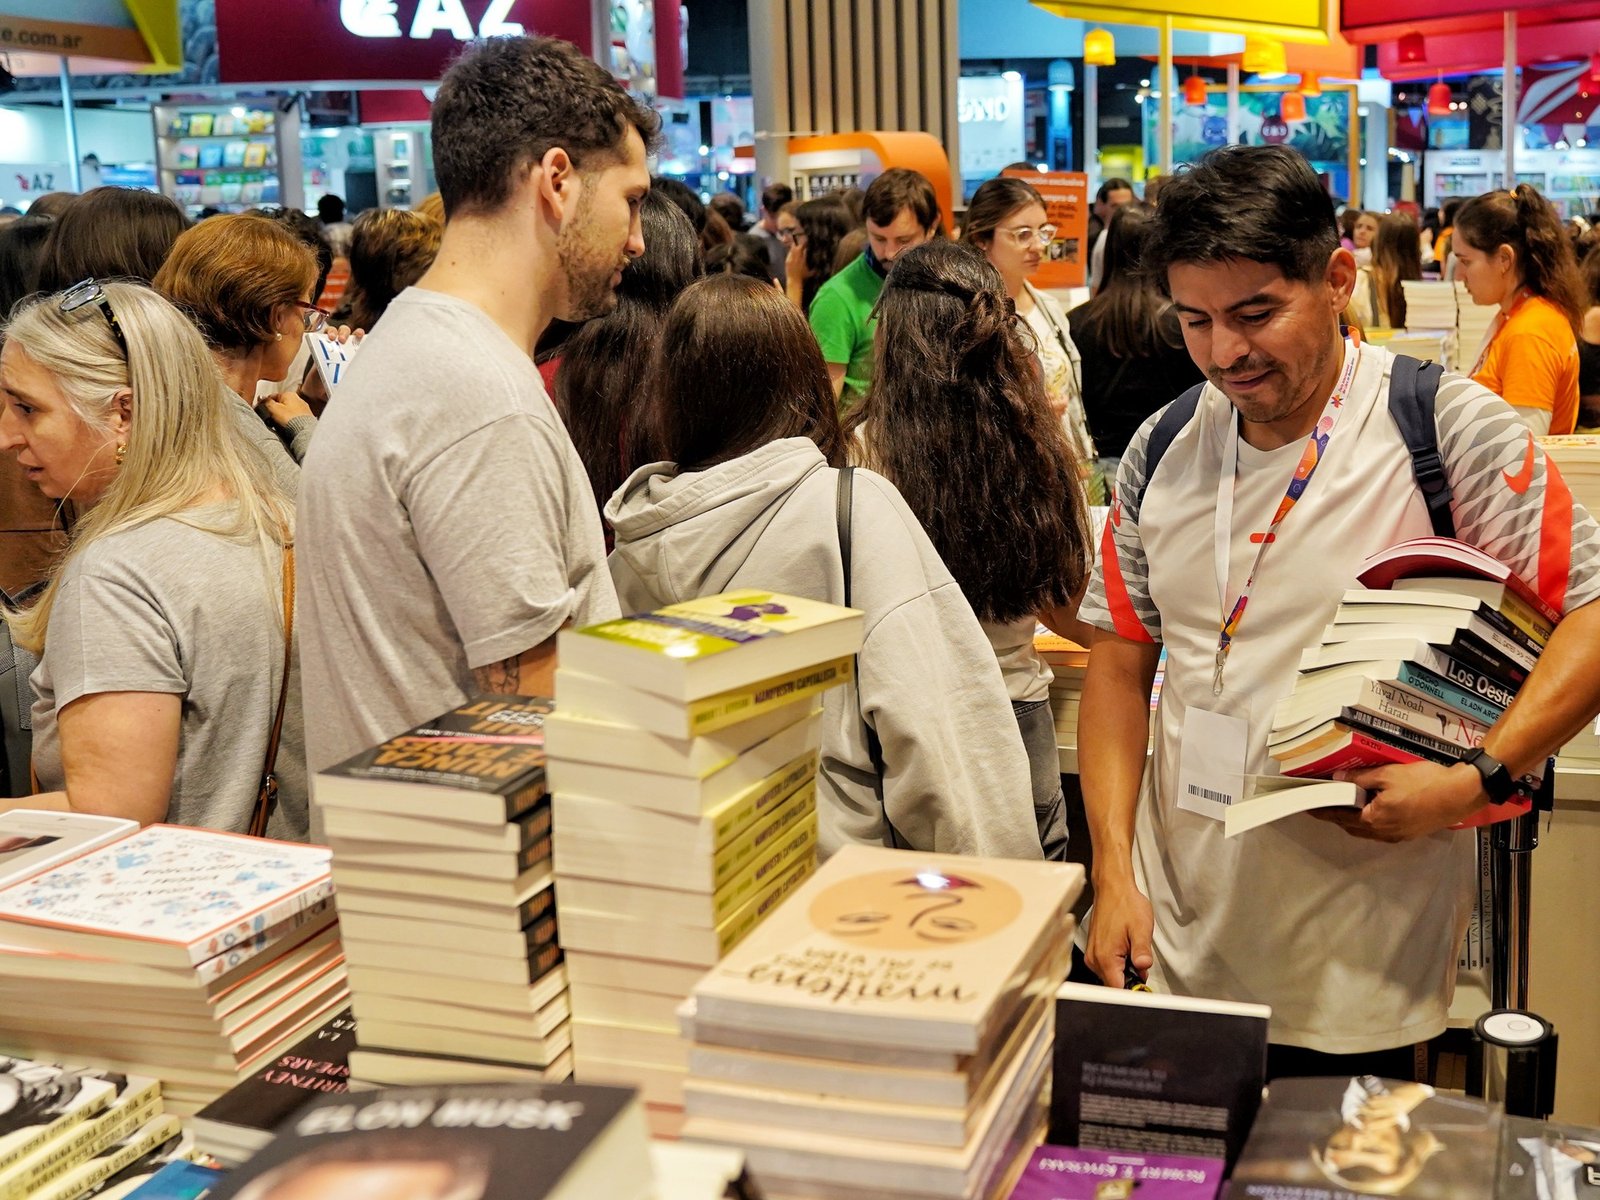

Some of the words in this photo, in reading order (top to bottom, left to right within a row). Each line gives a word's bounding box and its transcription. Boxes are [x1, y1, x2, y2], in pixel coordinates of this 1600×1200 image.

[409, 0, 525, 40] AZ
[32, 173, 54, 191] AZ
[1416, 671, 1441, 687] PACHO
[1449, 660, 1475, 688] Los
[1370, 680, 1396, 701] Yuval
[1398, 692, 1425, 714] Noah
[1408, 677, 1445, 700] O'DONNELL
[1378, 699, 1410, 721] Harari
[1460, 697, 1468, 706] EL
[1467, 700, 1483, 713] ADN
[1353, 711, 1372, 725] JUAN
[1372, 716, 1401, 735] GRABOIS
[1455, 717, 1484, 748] Ne
[378, 736, 514, 761] PARES
[373, 749, 526, 779] NUNCA
[1482, 836, 1490, 878] FRANCISCO
[1483, 888, 1492, 941] ESPERANZA
[317, 1030, 342, 1042] LA
[277, 1055, 350, 1078] SPEARS
[257, 1068, 349, 1095] BRITNEY
[294, 1099, 436, 1137] ELON
[431, 1099, 585, 1131] MUSK
